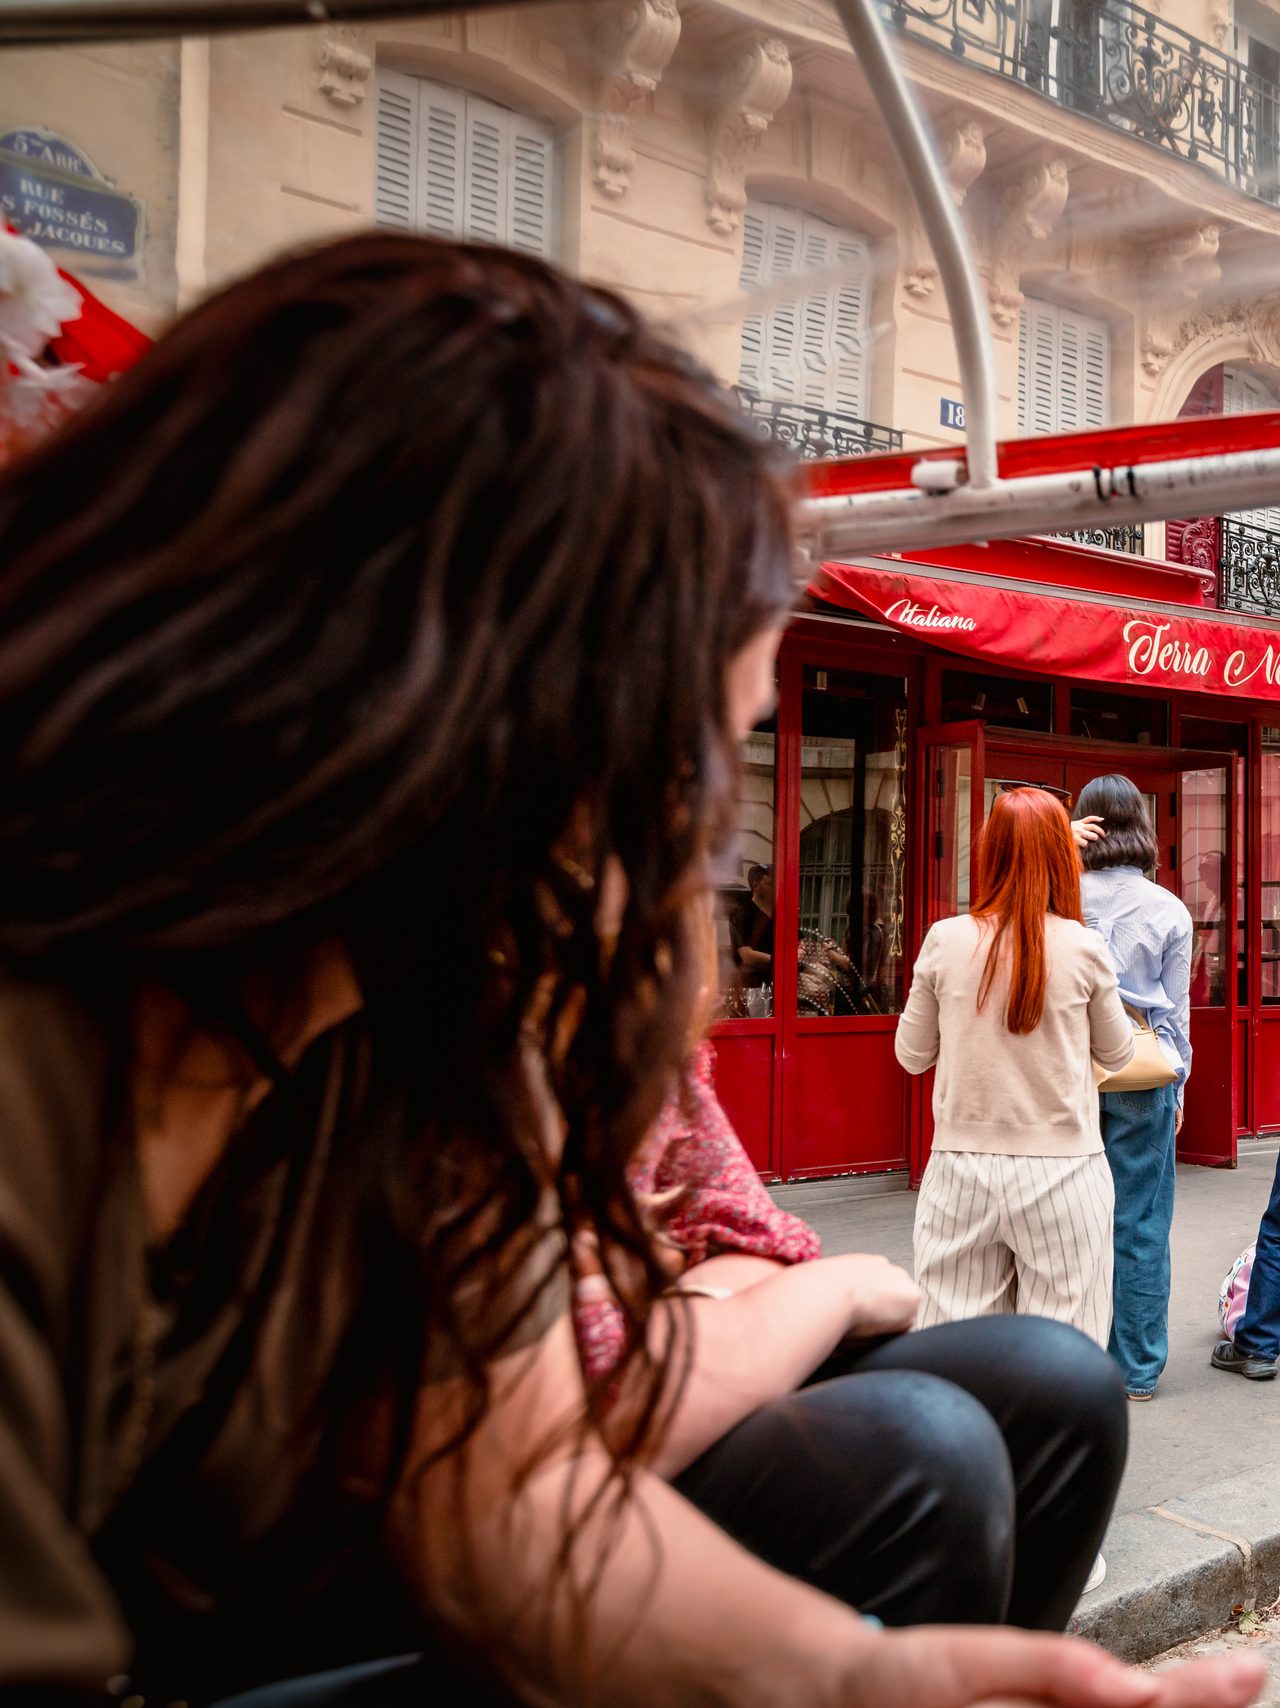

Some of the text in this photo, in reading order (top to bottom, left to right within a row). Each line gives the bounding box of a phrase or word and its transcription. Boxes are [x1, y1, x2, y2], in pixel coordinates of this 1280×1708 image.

[20, 178, 64, 206] RUE
[24, 200, 108, 234] FOSSÉS
[25, 221, 126, 254] JACQUES
[947, 403, 966, 427] 18
[884, 598, 977, 632] Italiana
[1122, 619, 1212, 676] Terra
